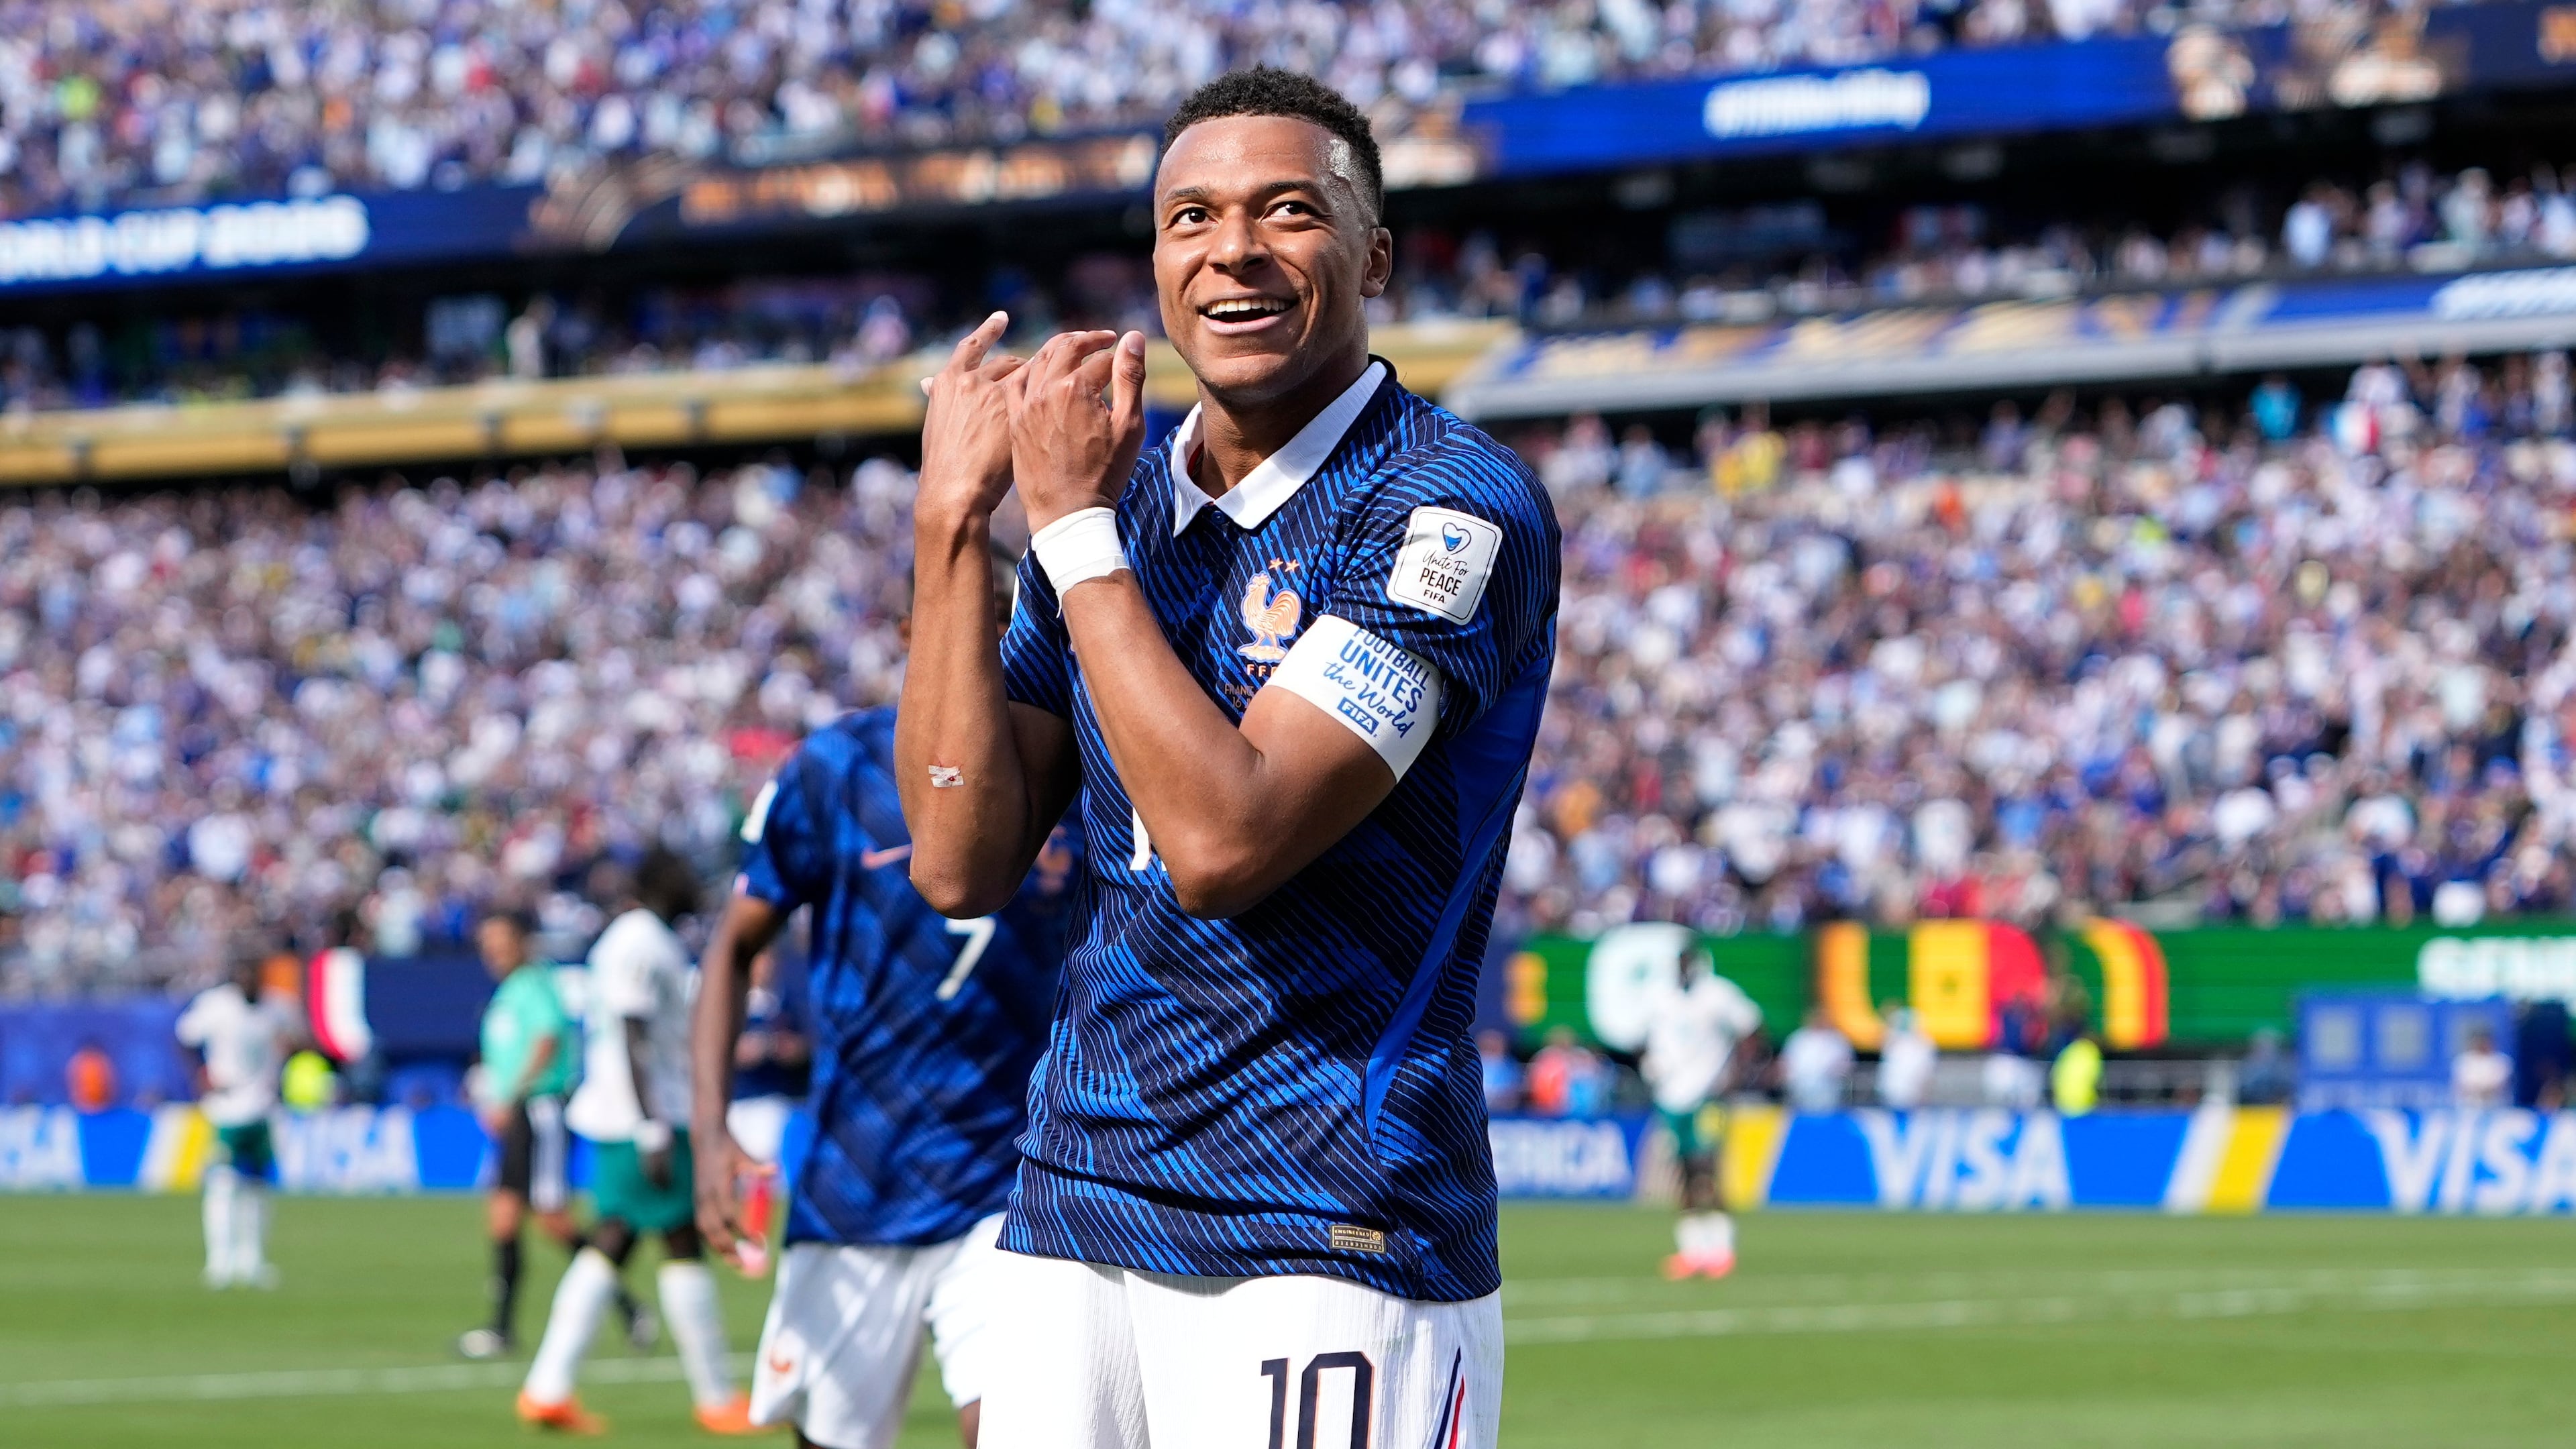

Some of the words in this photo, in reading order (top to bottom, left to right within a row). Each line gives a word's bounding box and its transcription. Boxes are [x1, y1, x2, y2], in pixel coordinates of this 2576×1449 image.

[1419, 568, 1462, 596] PEACE
[1423, 549, 1452, 570] Unite
[1453, 560, 1469, 576] For
[1424, 590, 1444, 603] FIFA
[1340, 639, 1422, 713] UNITES
[1354, 628, 1430, 691] FOOTBALL
[1323, 661, 1356, 690] the
[1357, 683, 1415, 739] World
[1340, 700, 1375, 732] FIFA
[934, 917, 997, 1001] 7
[1857, 1108, 2078, 1213] VISA
[2364, 1107, 2576, 1215] VISA
[1261, 1351, 1375, 1449] 10
